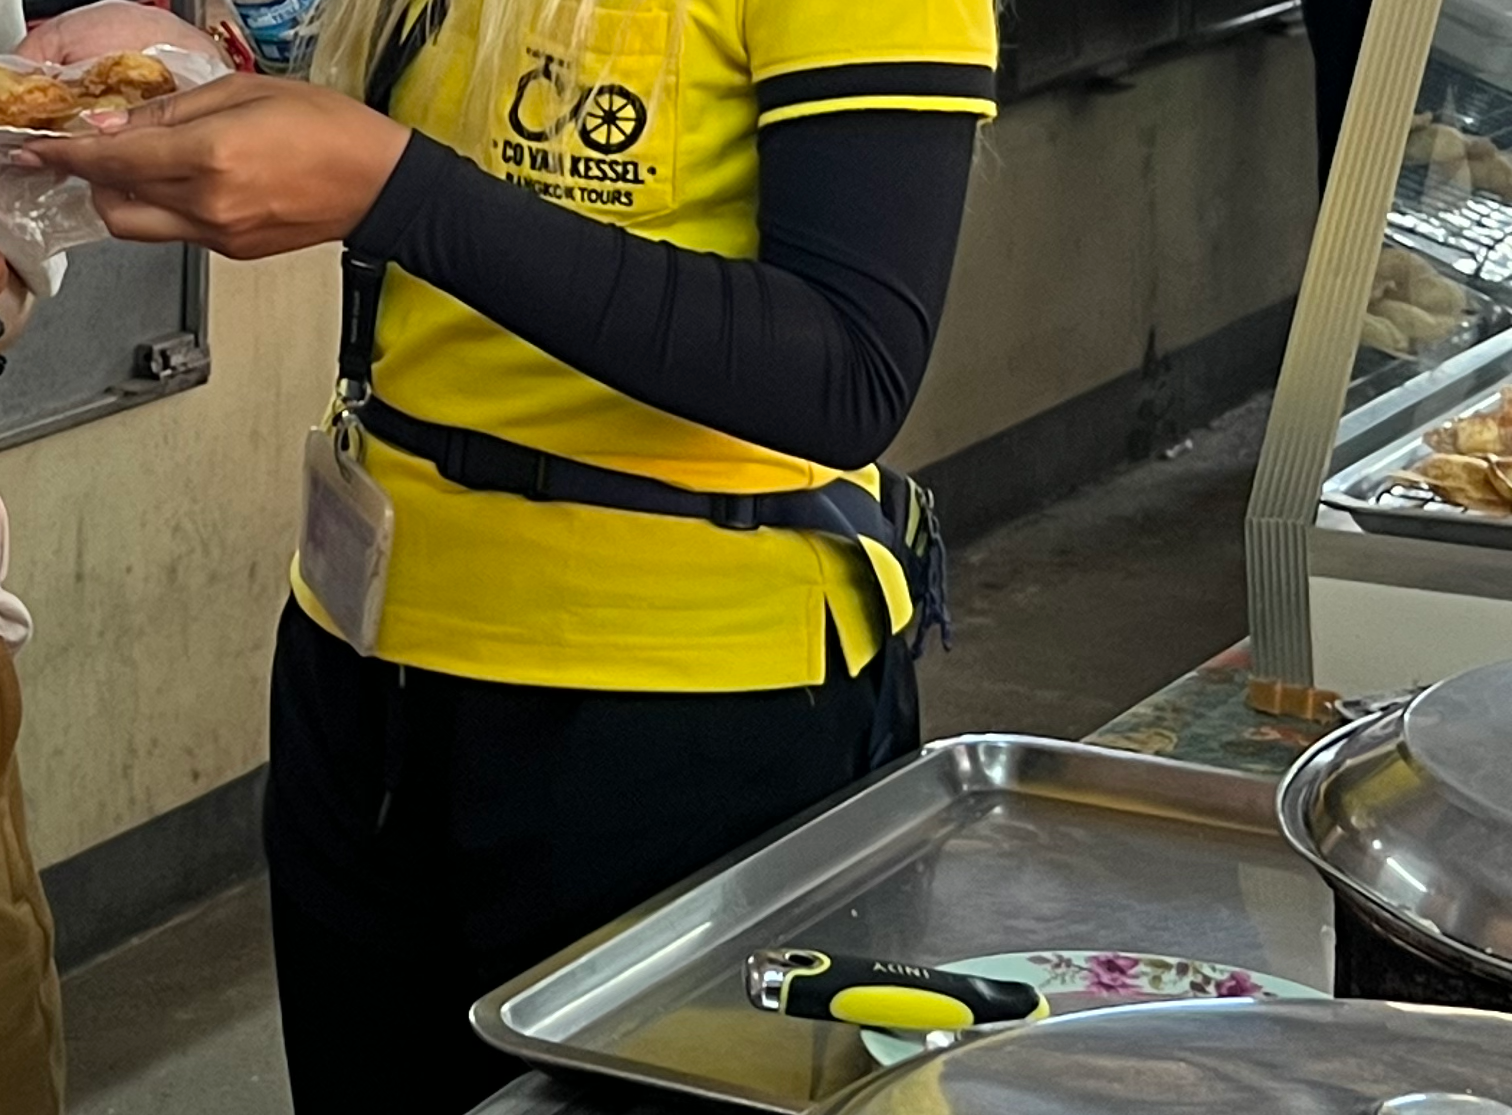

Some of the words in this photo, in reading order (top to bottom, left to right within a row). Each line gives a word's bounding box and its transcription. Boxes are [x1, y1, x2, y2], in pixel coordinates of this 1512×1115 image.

[502, 140, 524, 166] CO
[569, 155, 645, 185] KESSEL
[579, 187, 634, 207] TOURS
